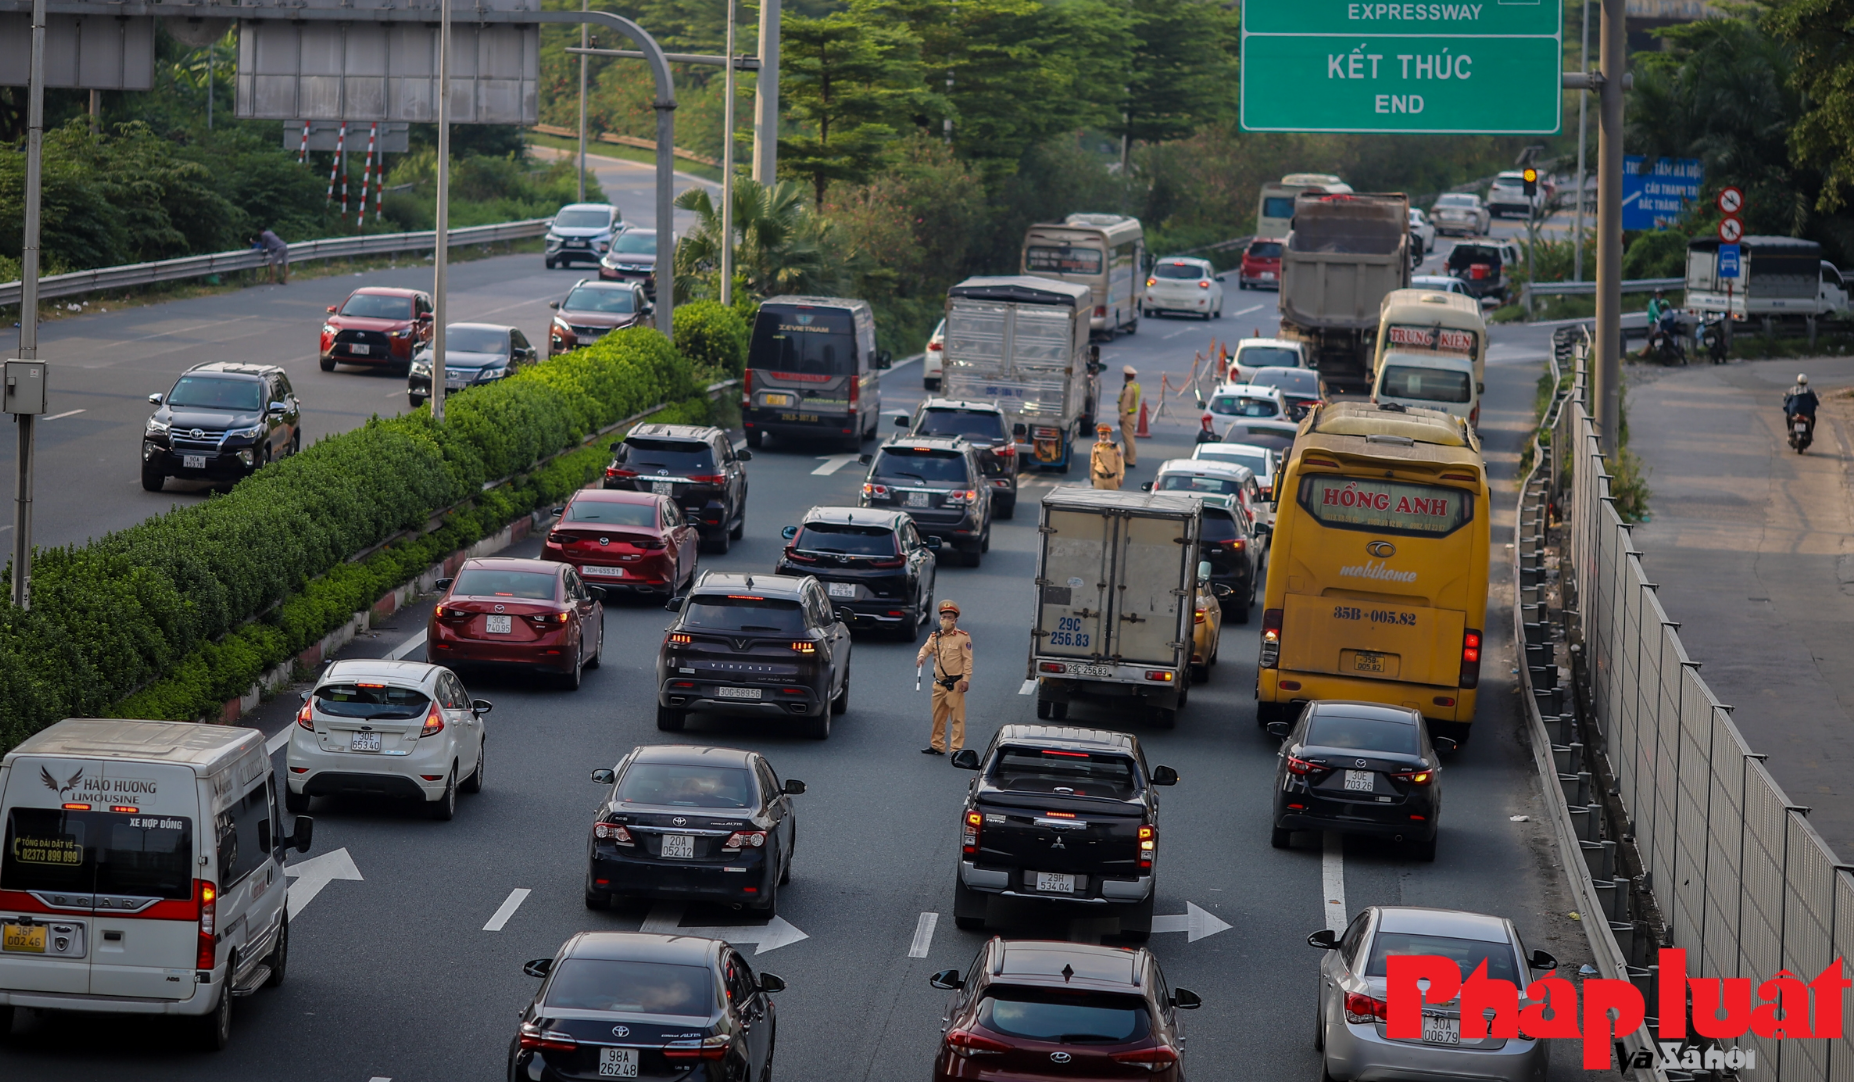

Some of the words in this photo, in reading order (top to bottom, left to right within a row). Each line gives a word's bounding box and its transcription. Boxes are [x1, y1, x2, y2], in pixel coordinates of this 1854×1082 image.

[1348, 4, 1483, 20] EXPRESSWAY
[1328, 43, 1383, 79] KẾT
[1397, 48, 1473, 80] THÚC
[1375, 94, 1425, 114] END
[1390, 327, 1433, 345] TRUNG
[1440, 330, 1472, 349] KIÊN
[1322, 481, 1390, 511] HỒNG
[1394, 495, 1449, 517] ANH
[1339, 560, 1418, 583] mobihome
[492, 616, 506, 624] 30E
[1333, 605, 1361, 620] 35B
[1370, 609, 1416, 626] 005.82
[1059, 617, 1081, 632] 29C
[1050, 631, 1089, 647] 256.83
[359, 732, 375, 740] 30E
[352, 740, 380, 750] 653.40
[1352, 771, 1367, 780] 30E
[72, 793, 140, 804] LIMOUSINE
[130, 817, 140, 827] XE
[669, 836, 686, 846] 20A
[22, 848, 46, 861] 02373
[47, 849, 61, 862] 899
[63, 850, 78, 863] 899
[663, 846, 692, 857] 052.12
[1048, 873, 1064, 883] 29H
[1040, 881, 1070, 891] 534.04
[16, 926, 34, 936] 36F
[7, 936, 41, 946] 002.46
[1433, 1018, 1451, 1030] 30A
[1424, 1030, 1458, 1043] 006.79
[608, 1050, 629, 1062] 98A
[600, 1062, 637, 1077] 262.48
